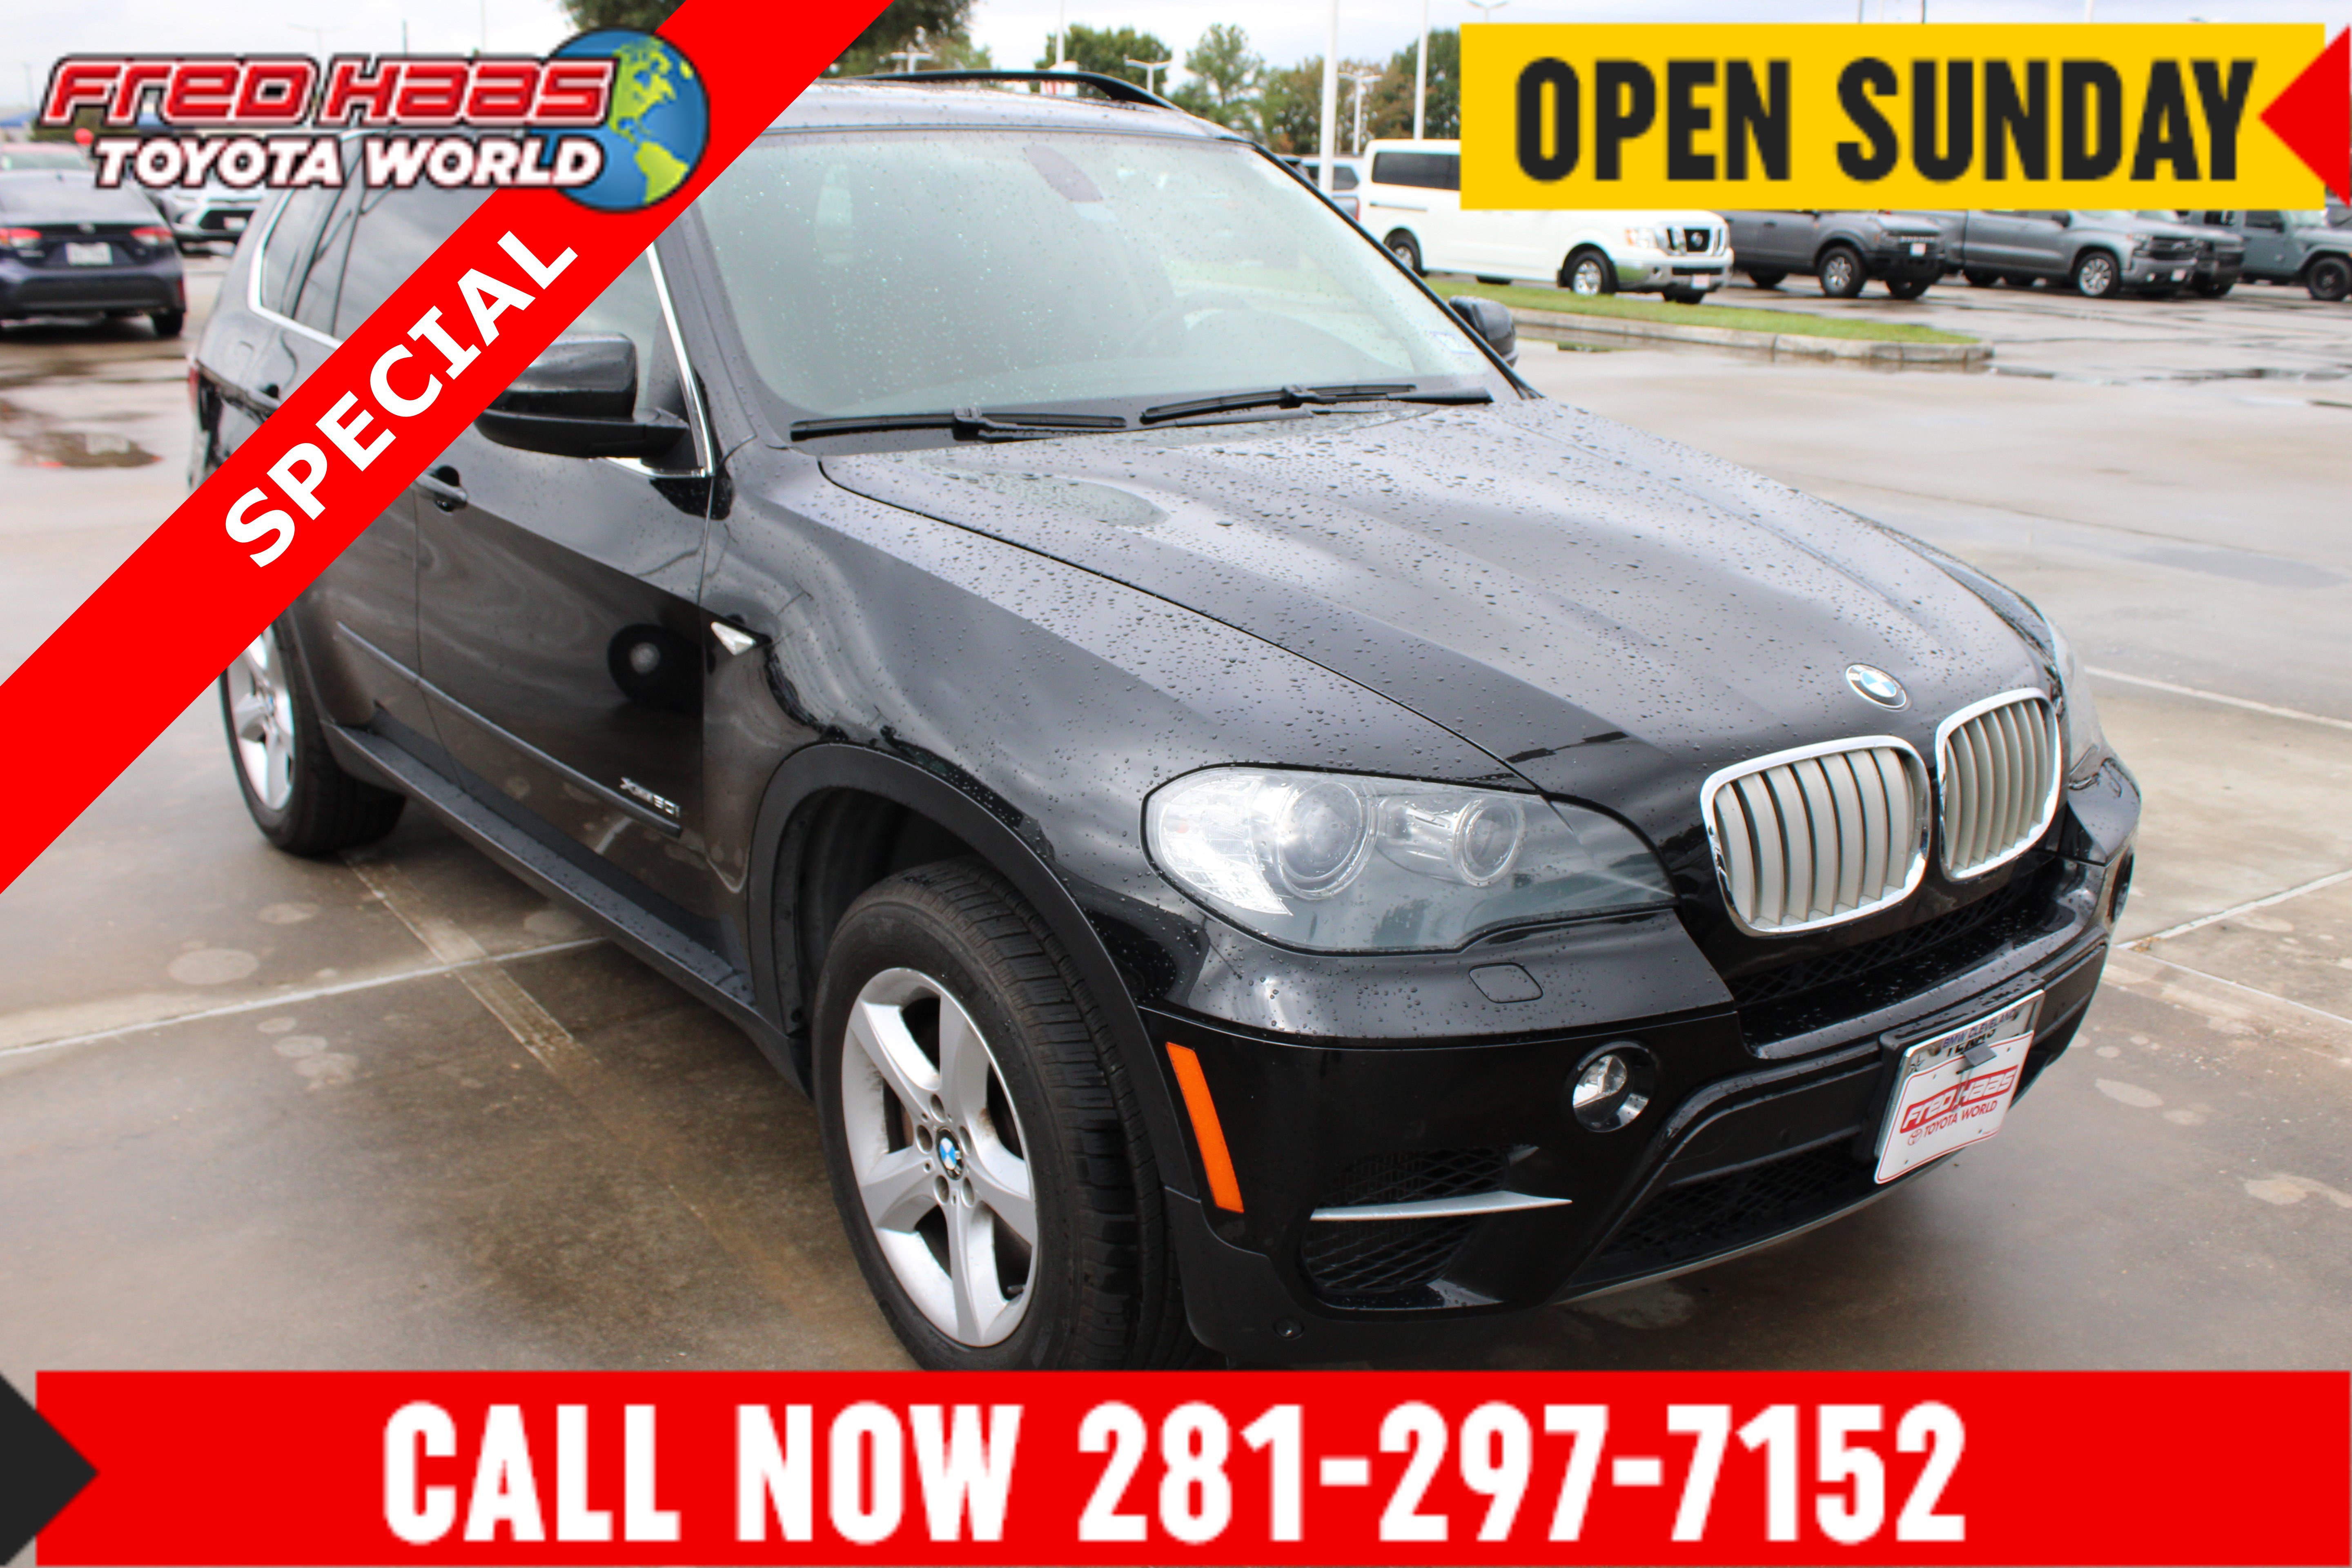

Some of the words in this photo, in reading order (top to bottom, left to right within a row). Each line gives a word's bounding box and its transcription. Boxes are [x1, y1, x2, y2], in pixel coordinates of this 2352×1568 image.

[1942, 1031, 1967, 1048] BMW
[1924, 1114, 1958, 1133] TOYOTA
[1961, 1100, 1998, 1121] WORLD
